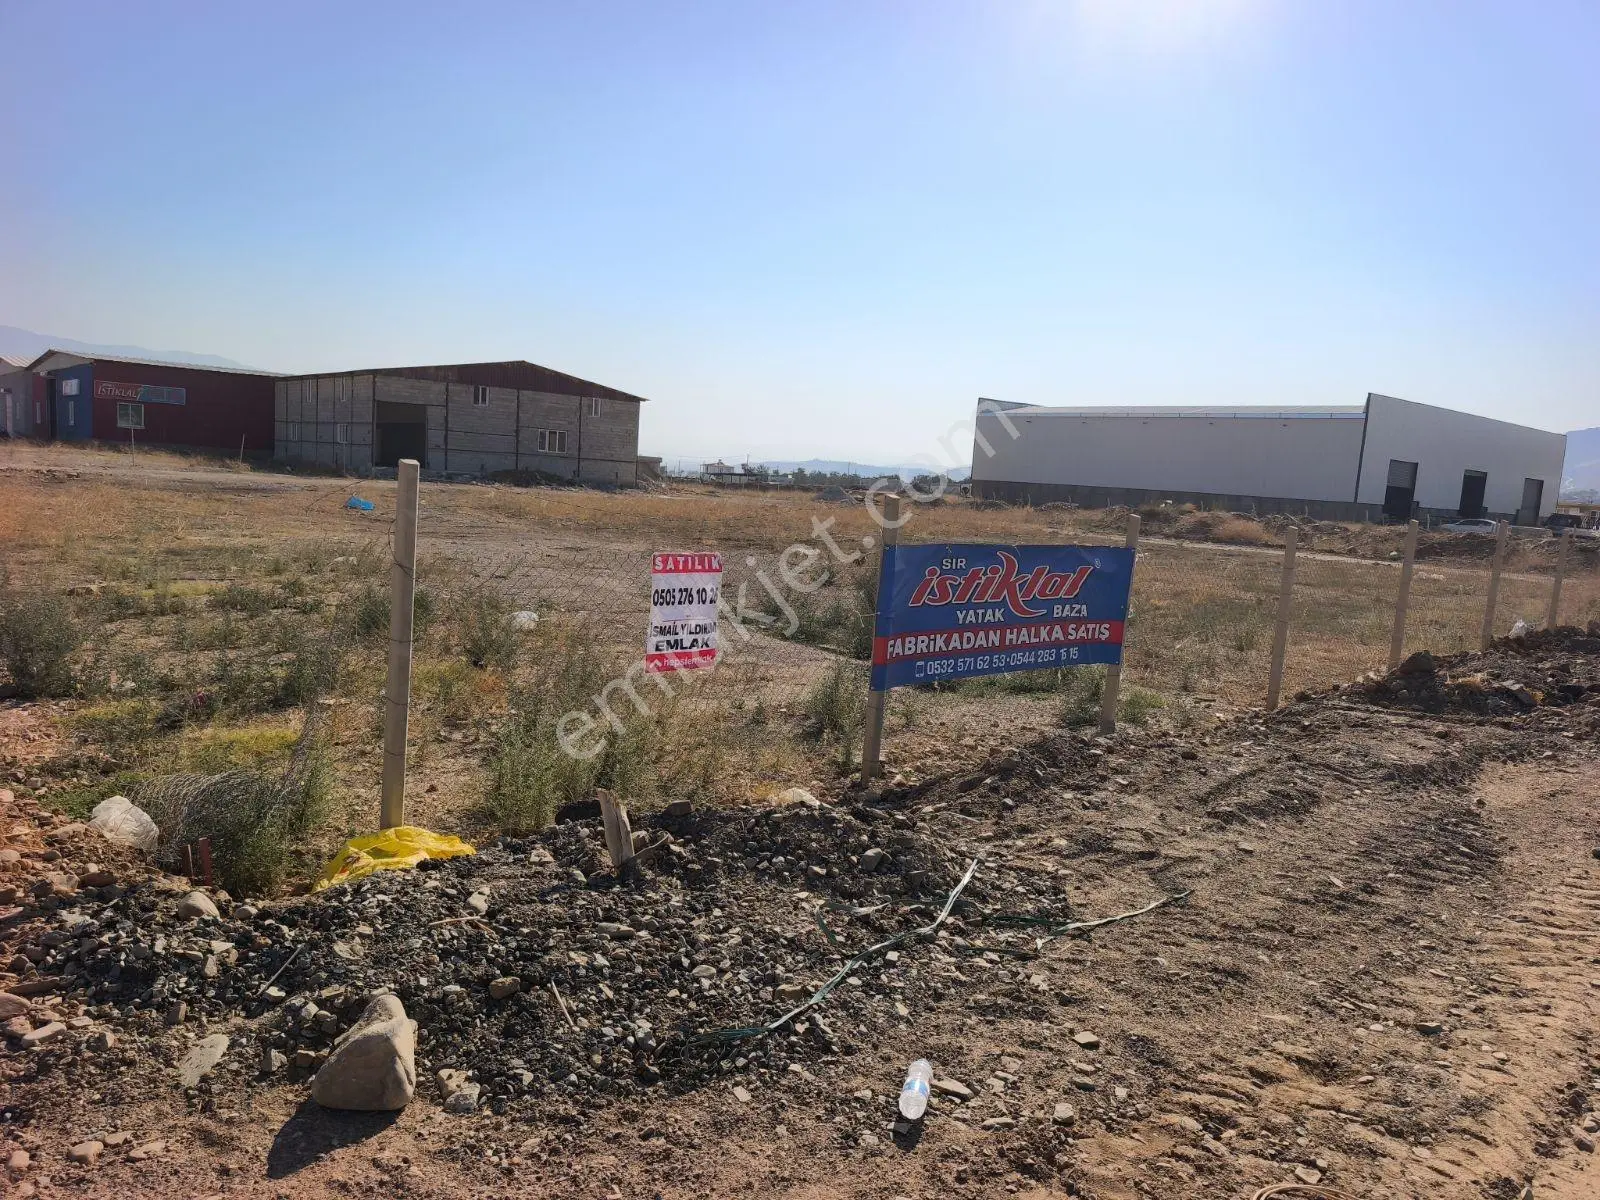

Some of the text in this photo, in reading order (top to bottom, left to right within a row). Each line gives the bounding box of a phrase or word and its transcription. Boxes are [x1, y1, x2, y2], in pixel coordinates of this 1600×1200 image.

[654, 556, 720, 571] SATILIK
[942, 558, 966, 570] SIR
[652, 588, 676, 607] 0505
[678, 587, 694, 606] 276
[696, 587, 708, 605] 10
[956, 609, 1005, 625] YATAK
[1053, 604, 1088, 618] BAZA
[1005, 624, 1065, 646] HALKA
[1067, 623, 1111, 641] SATIŞ
[655, 637, 710, 652] EMLAK
[927, 659, 955, 675] 0532
[957, 657, 975, 672] 571
[976, 655, 990, 670] 62
[1037, 648, 1056, 663] 283
[1069, 647, 1079, 660] 15
